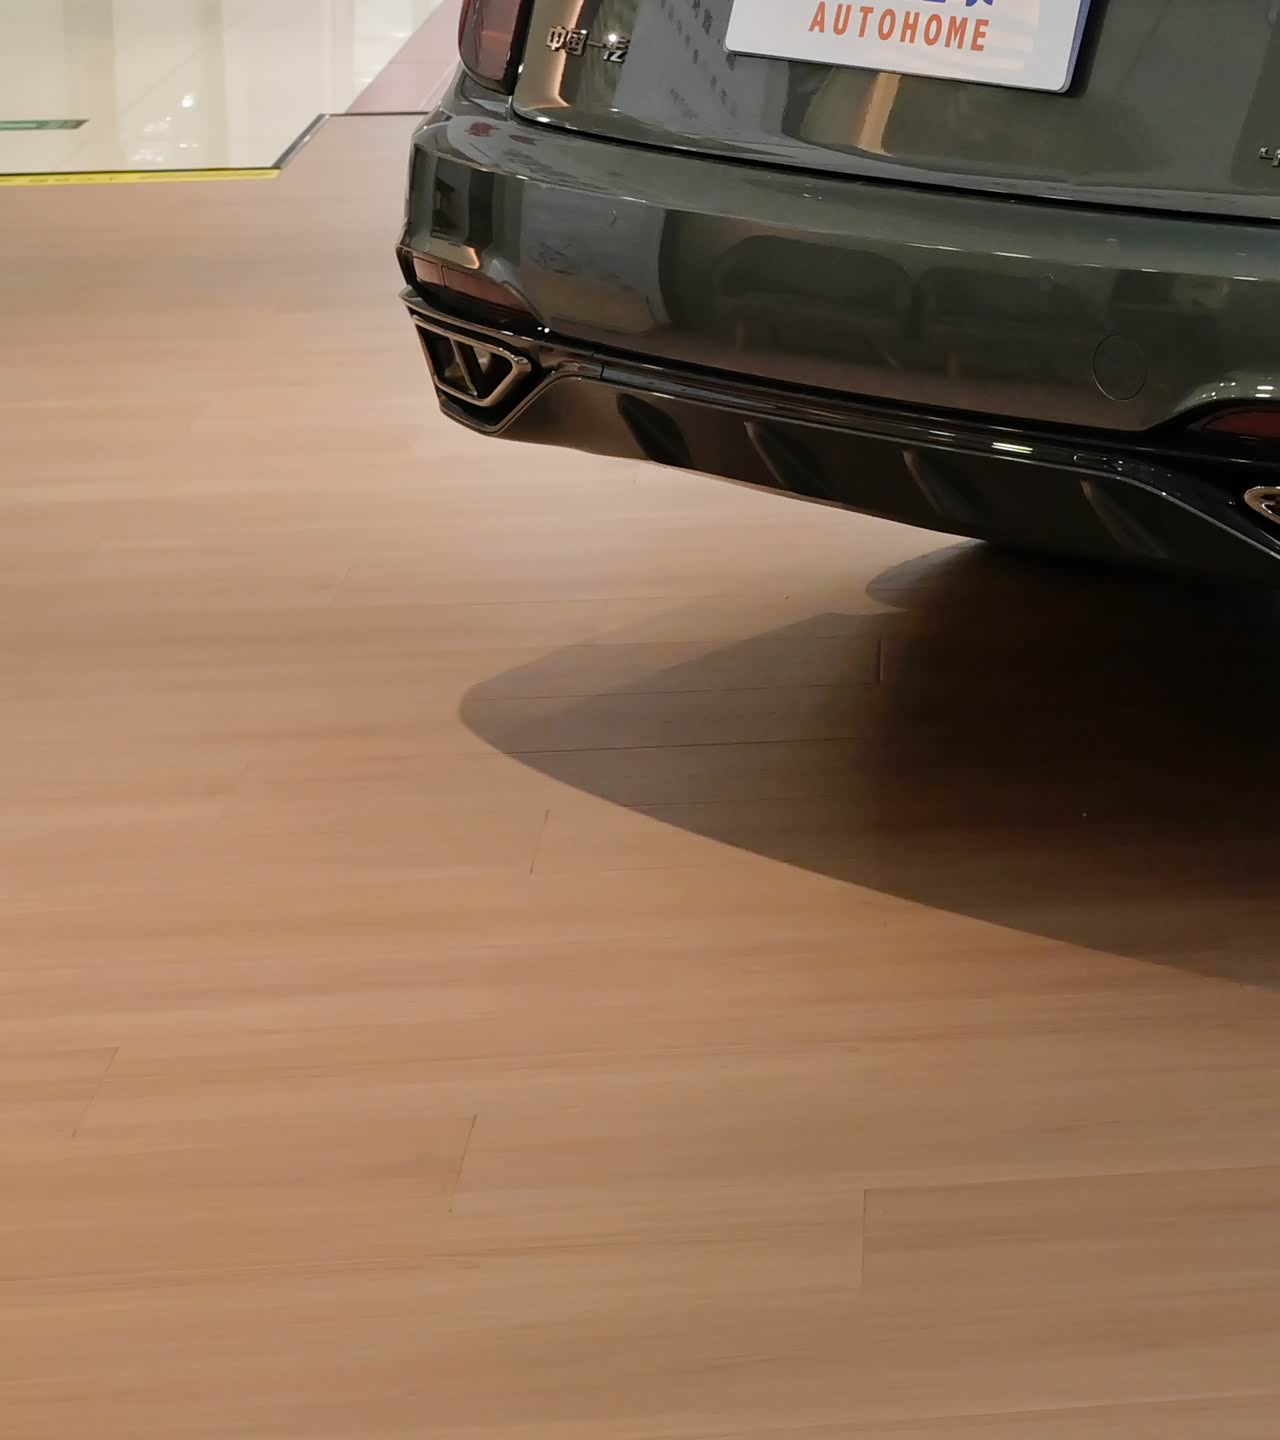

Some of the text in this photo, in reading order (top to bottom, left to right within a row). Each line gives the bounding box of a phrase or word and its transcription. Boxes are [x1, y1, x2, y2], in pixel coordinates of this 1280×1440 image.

[546, 26, 631, 64] 中国一汽
[808, 1, 990, 52] AUTOHOME
